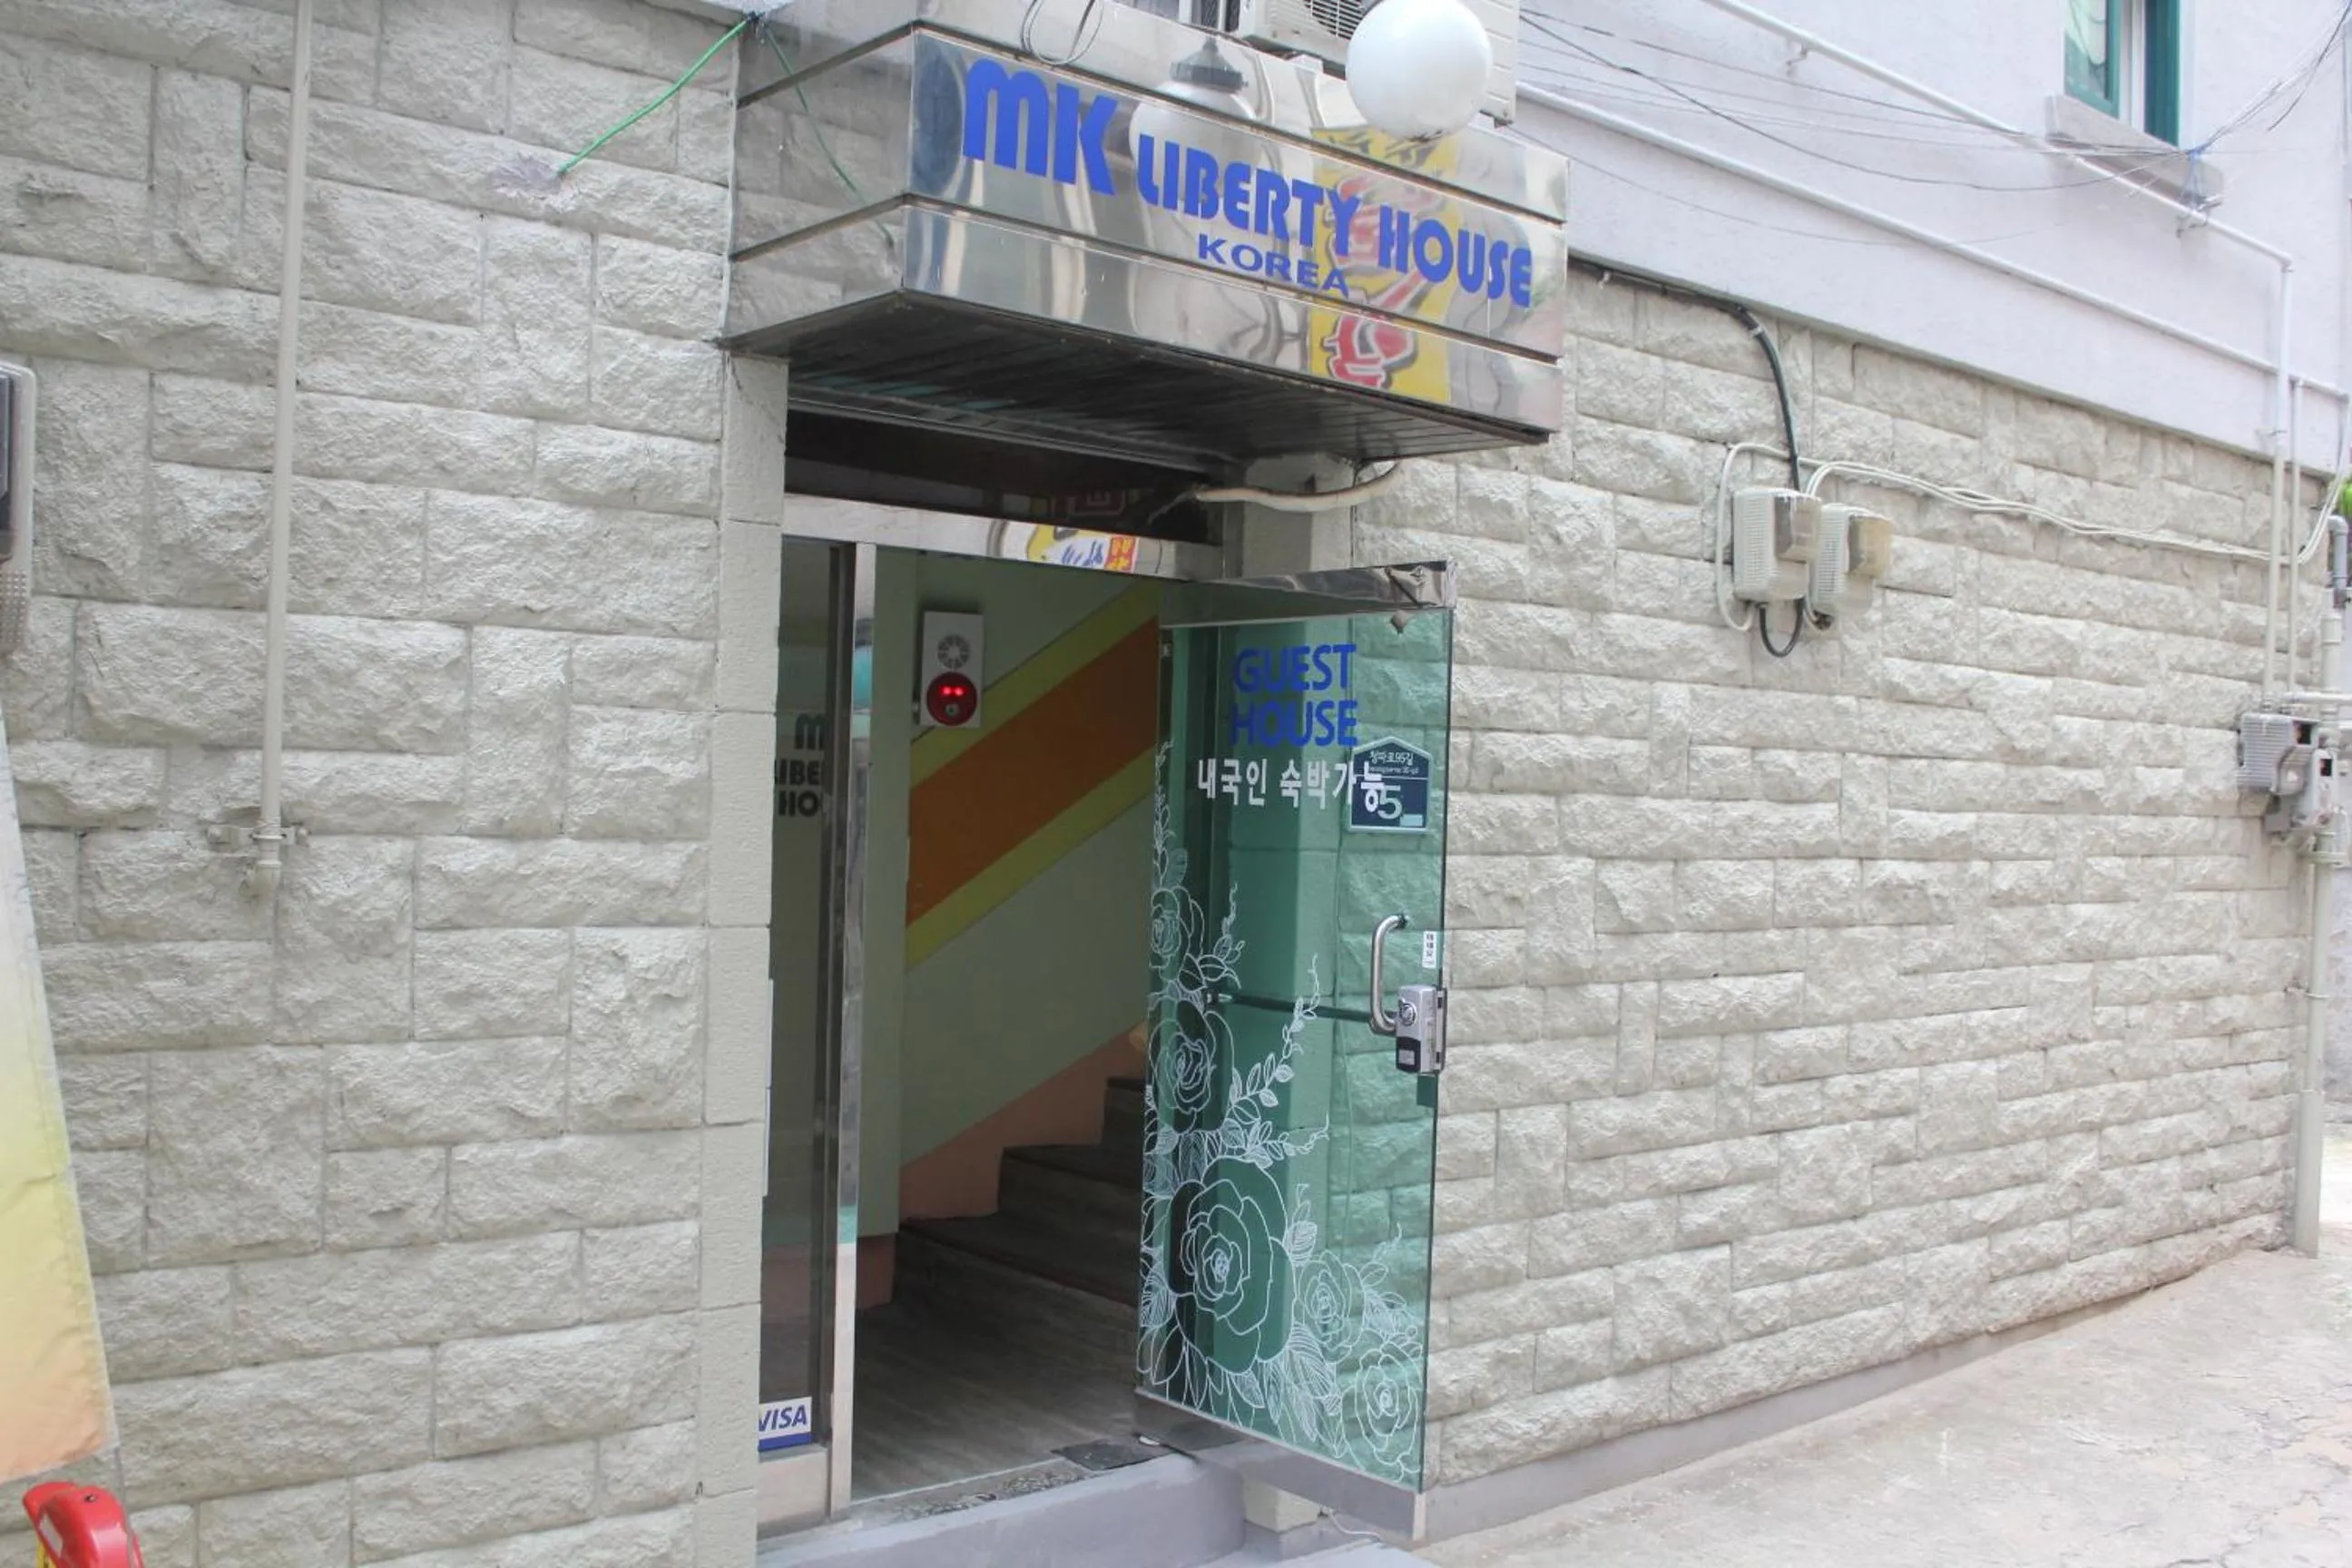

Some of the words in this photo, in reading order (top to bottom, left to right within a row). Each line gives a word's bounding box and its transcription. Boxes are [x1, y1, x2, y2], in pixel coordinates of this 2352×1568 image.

[962, 57, 1119, 197] MK
[1137, 132, 1361, 258] LIBERTY
[1377, 211, 1533, 309] HOUSE
[1199, 234, 1350, 298] KOREA
[1234, 643, 1357, 694] GUEST
[1230, 700, 1359, 748] HOUSE
[1198, 759, 1269, 807] 내국인
[1279, 760, 1386, 813] 숙박가능
[759, 1404, 808, 1432] VISA
